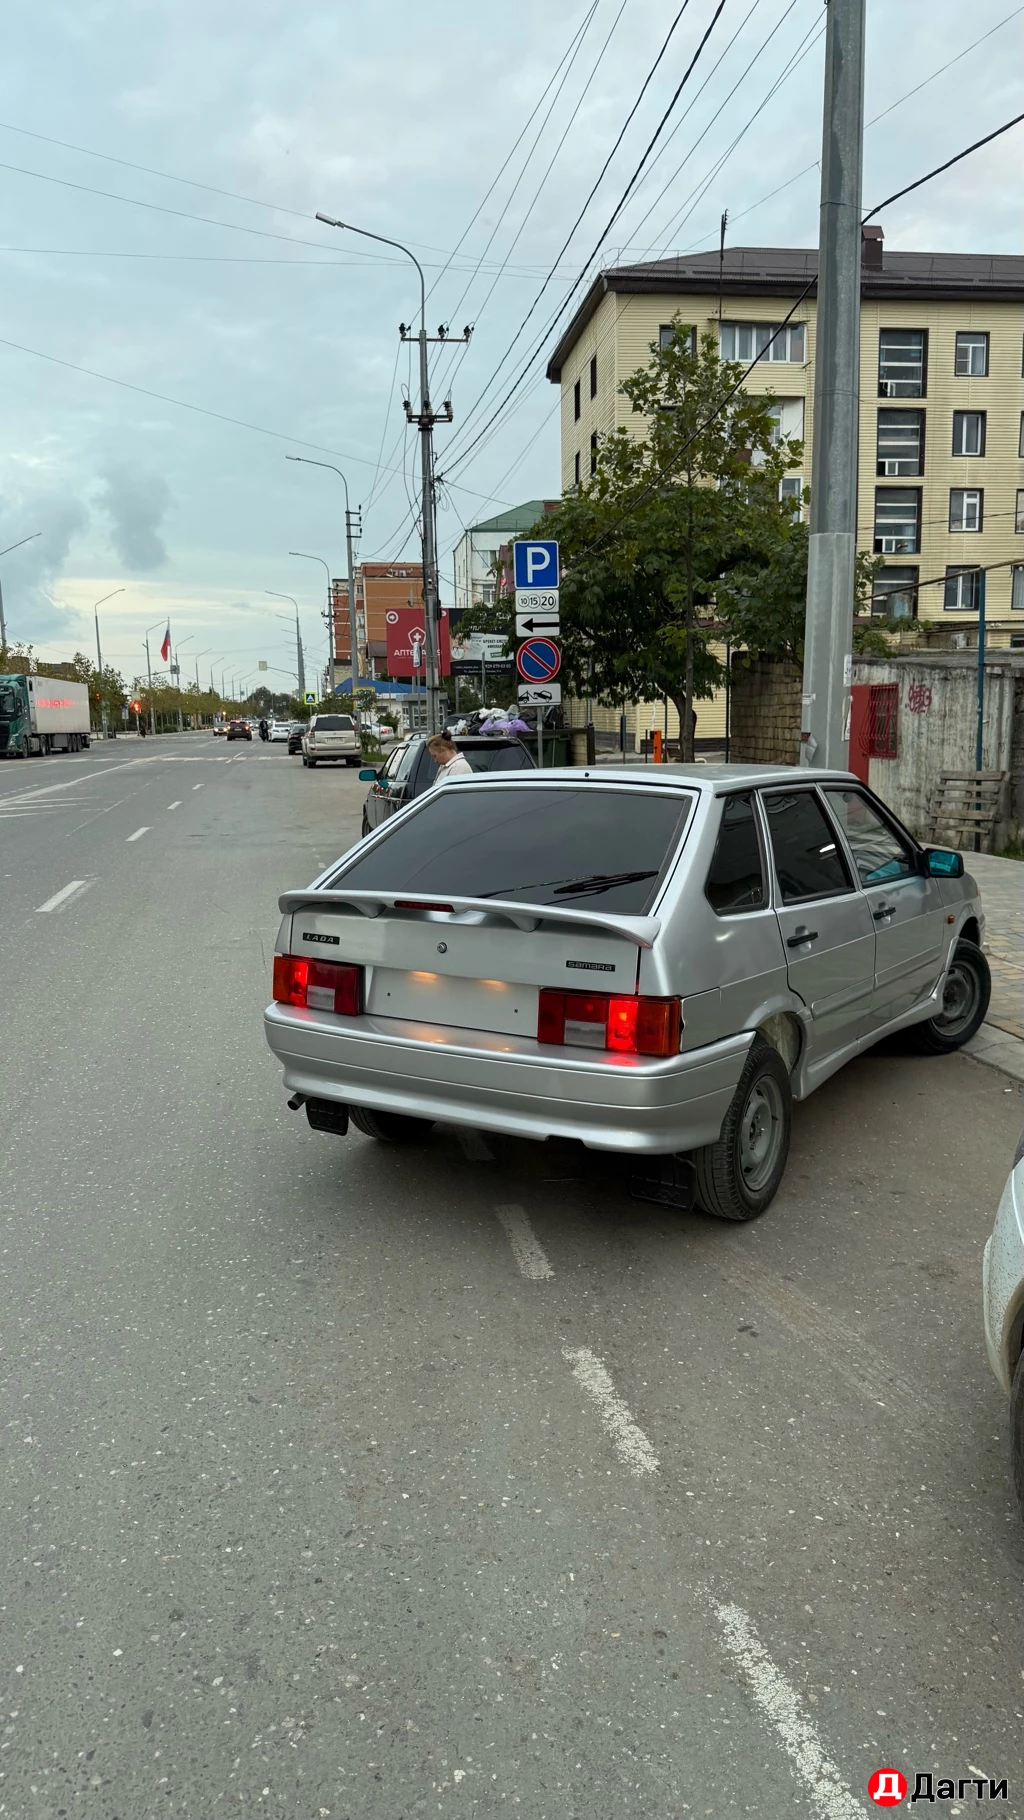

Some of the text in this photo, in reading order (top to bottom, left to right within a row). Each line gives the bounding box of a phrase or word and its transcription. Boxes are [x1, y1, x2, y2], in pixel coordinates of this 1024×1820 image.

[526, 546, 551, 583] P
[530, 597, 538, 605] 15
[541, 596, 554, 606] 20
[306, 934, 334, 943] LADA
